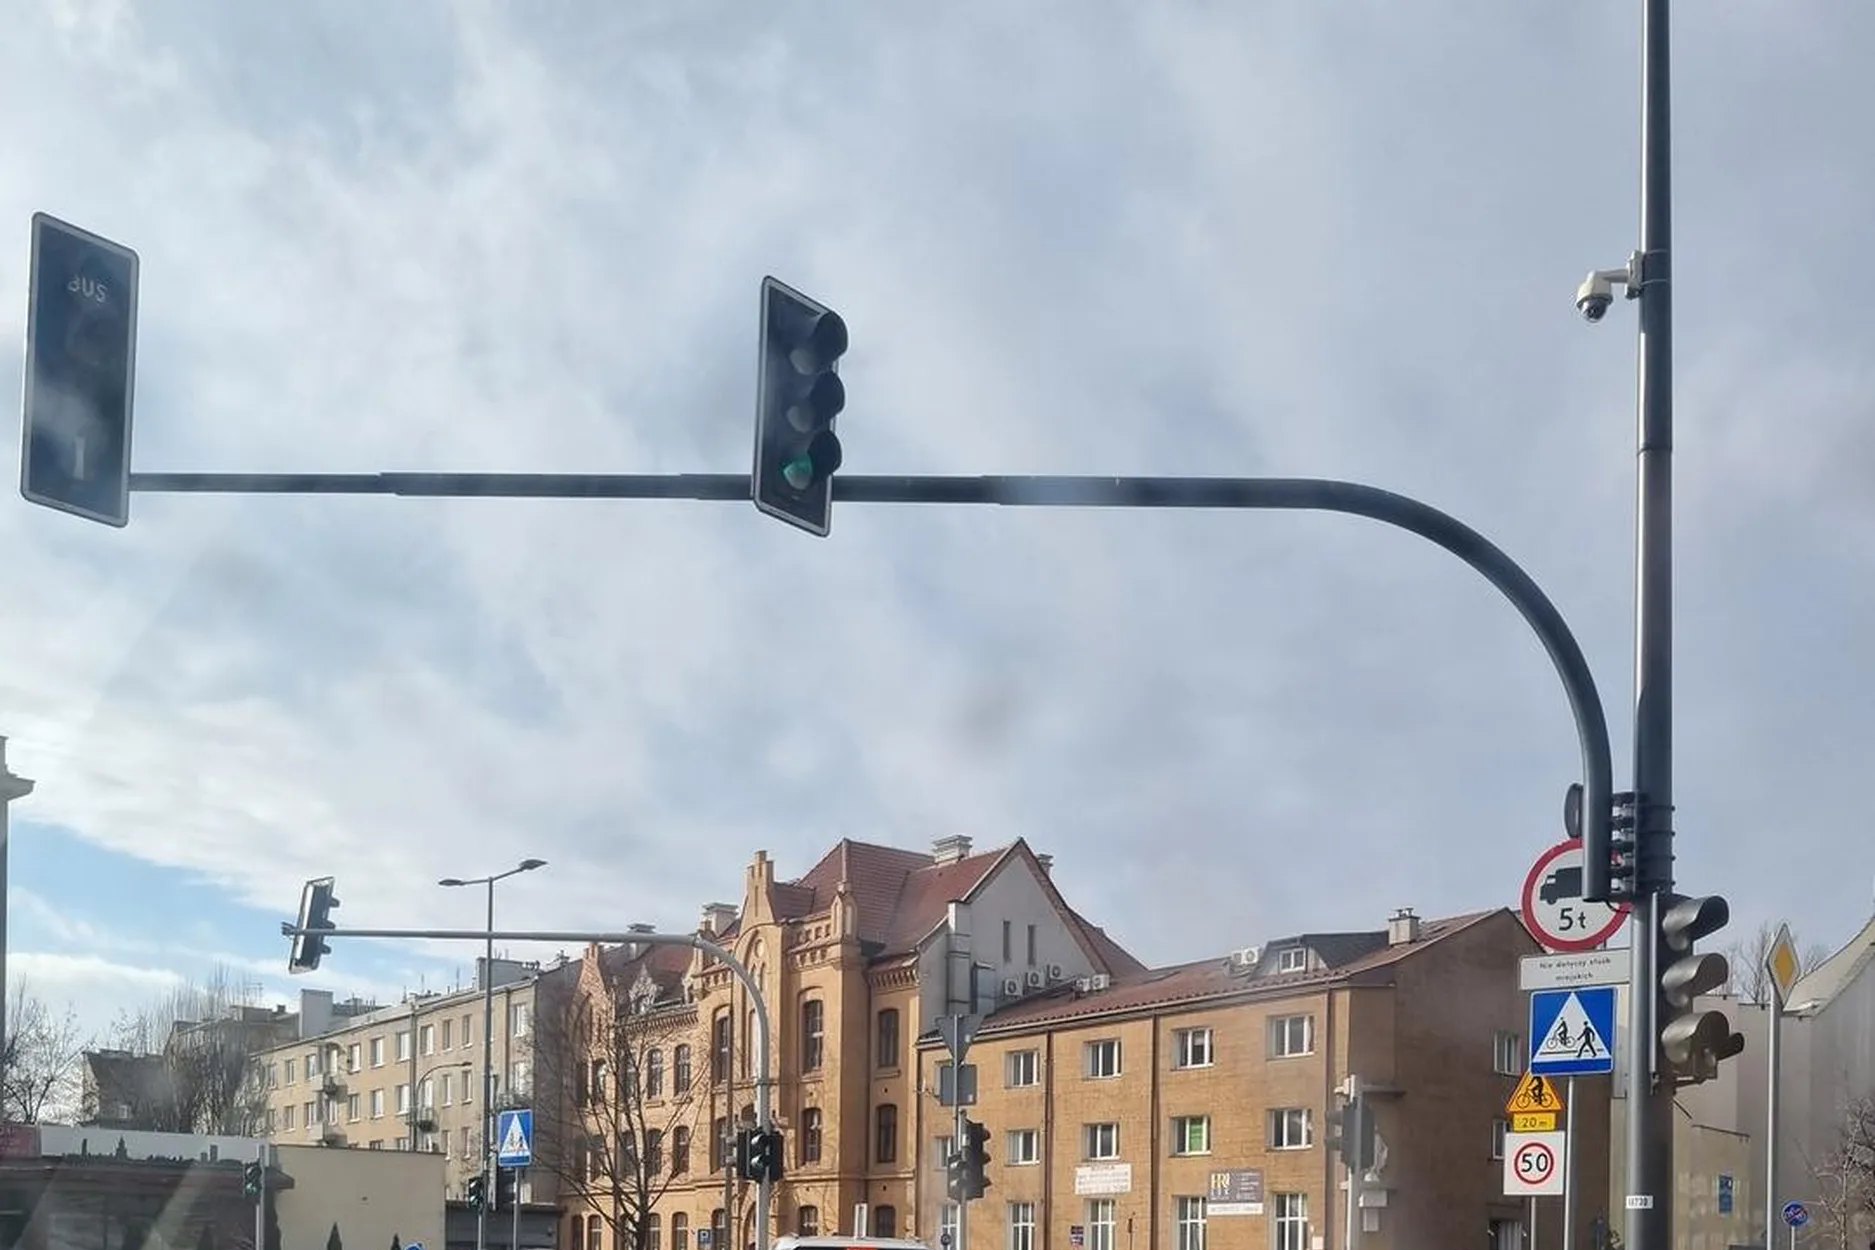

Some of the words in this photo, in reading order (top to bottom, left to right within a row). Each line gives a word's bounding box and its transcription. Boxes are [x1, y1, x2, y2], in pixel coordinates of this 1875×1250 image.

[1522, 1117, 1537, 1128] 20
[1521, 1153, 1549, 1173] 50
[700, 1231, 709, 1242] P
